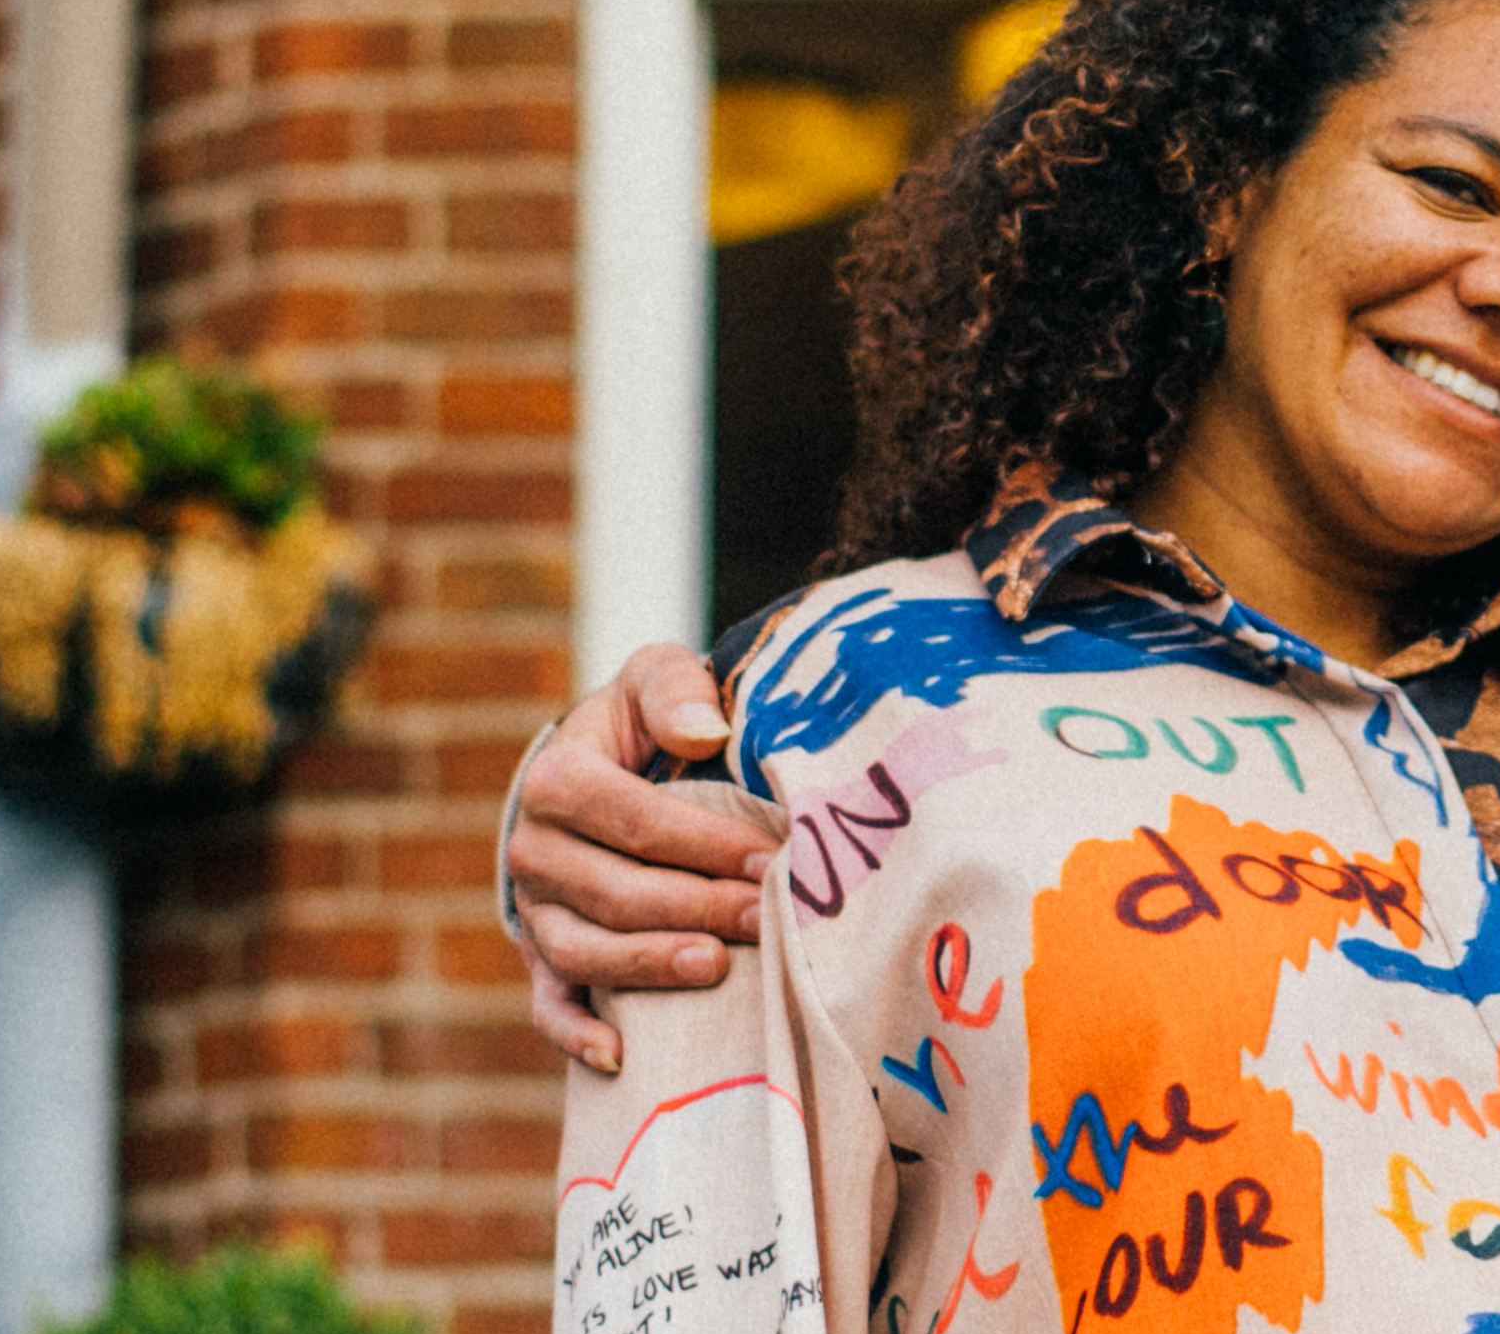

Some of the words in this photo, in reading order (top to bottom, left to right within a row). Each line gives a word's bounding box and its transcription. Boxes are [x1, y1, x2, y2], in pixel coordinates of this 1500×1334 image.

[1039, 704, 1307, 795] OUT
[592, 1193, 638, 1251] ARE
[596, 1204, 693, 1277] ALIVE!
[631, 1264, 699, 1310] LOVE
